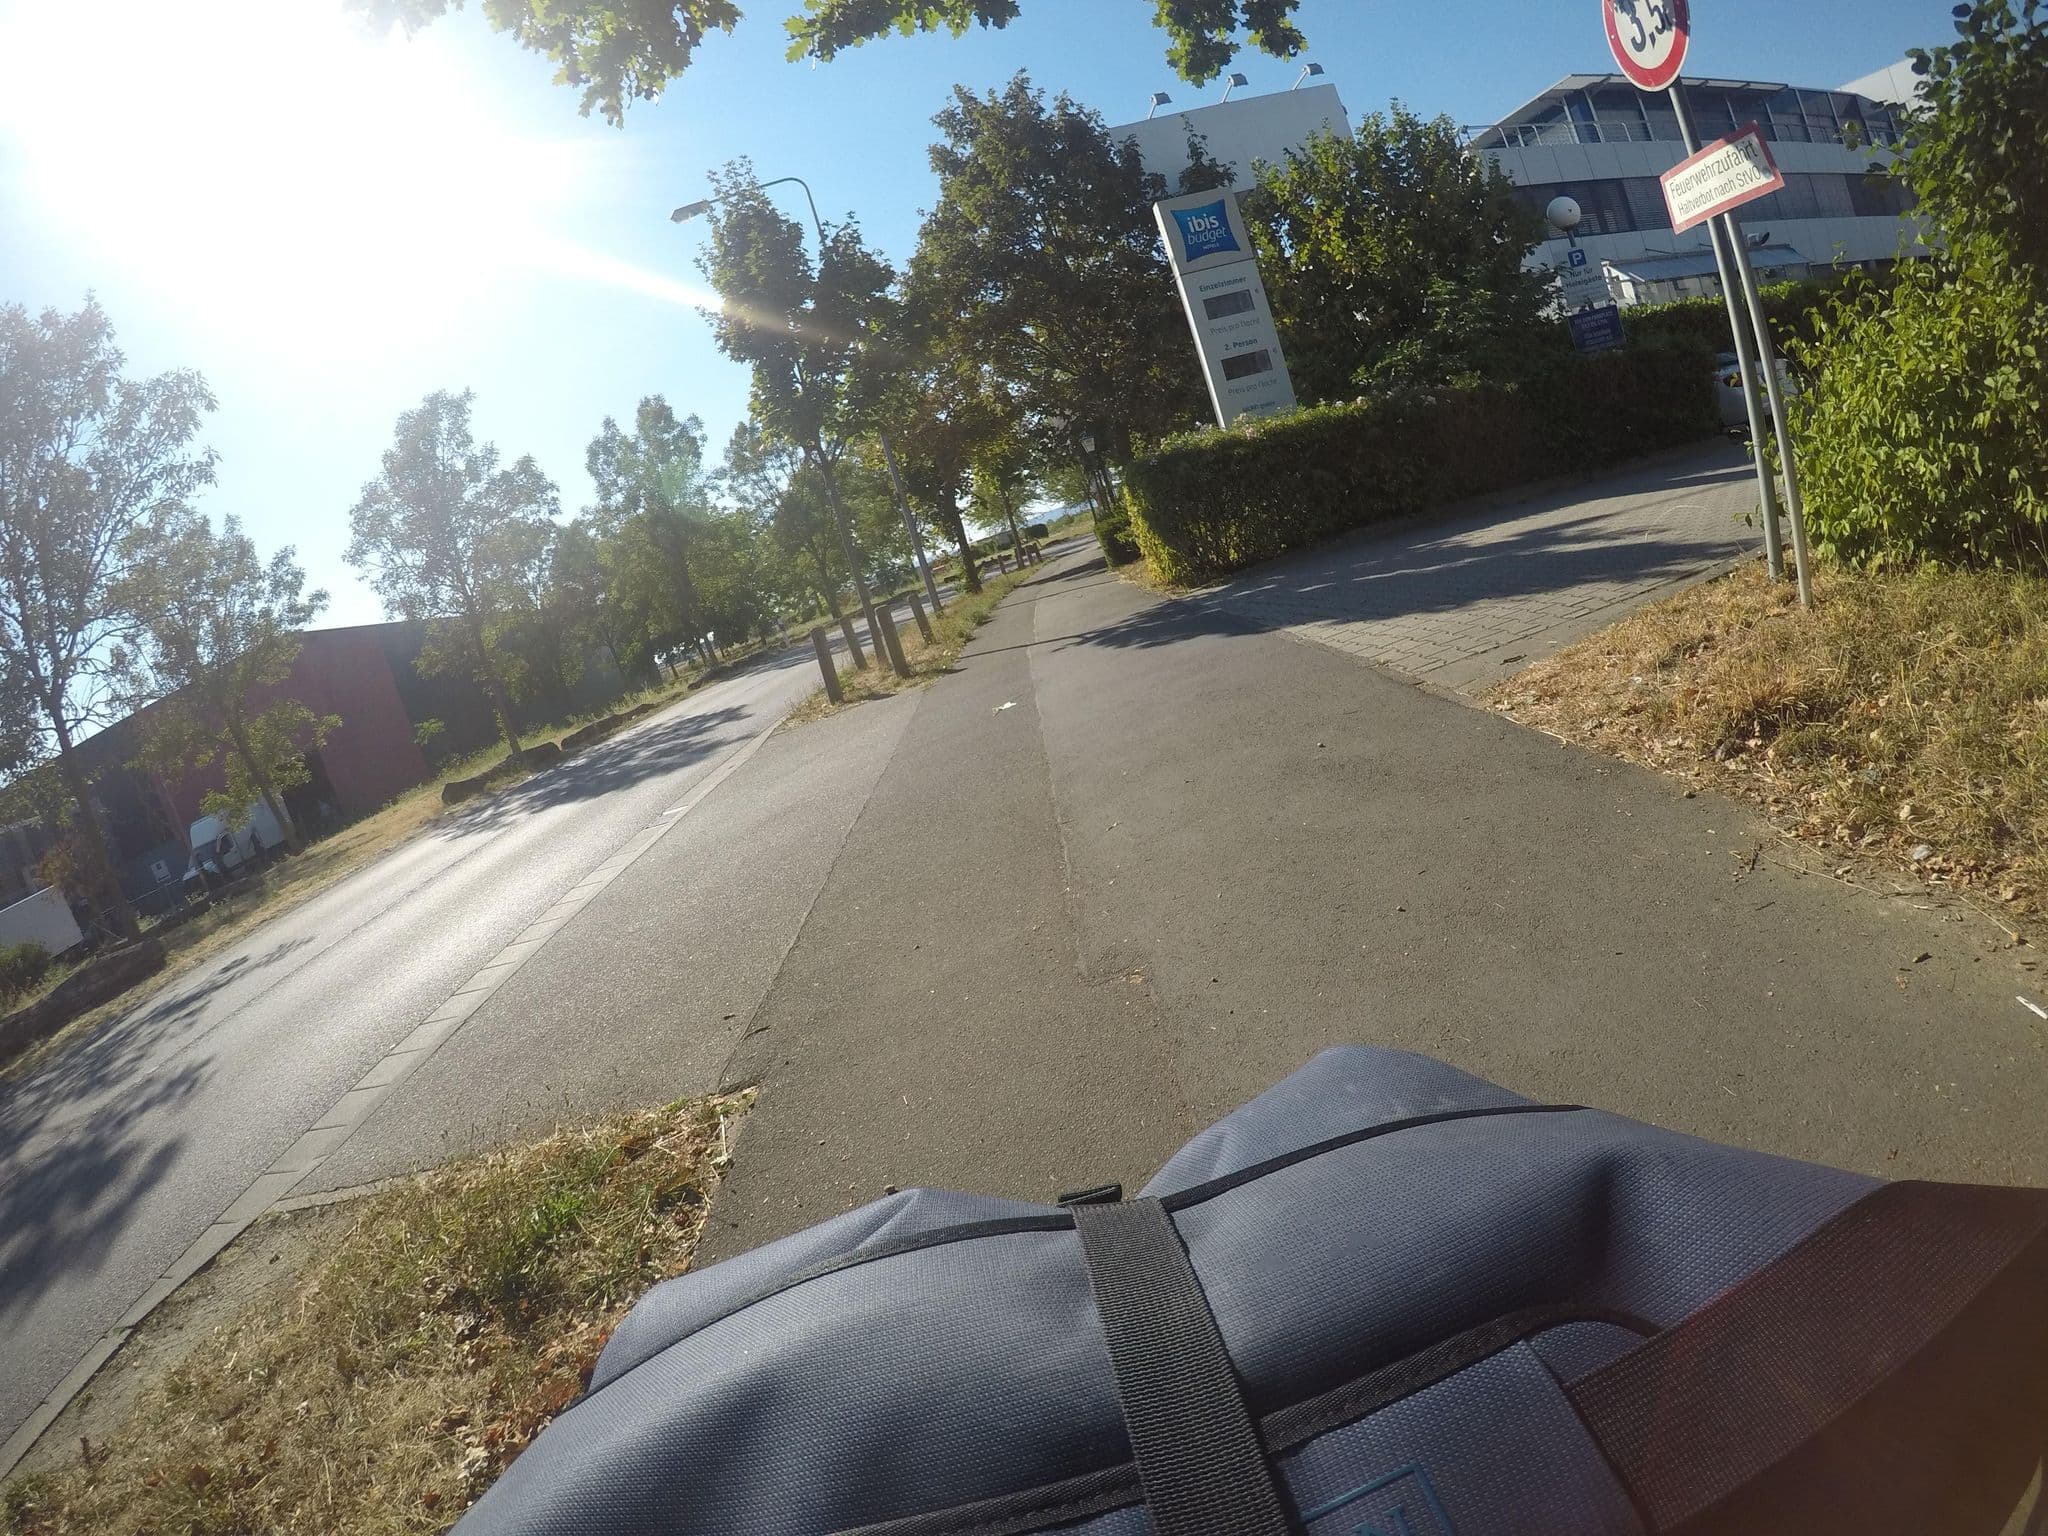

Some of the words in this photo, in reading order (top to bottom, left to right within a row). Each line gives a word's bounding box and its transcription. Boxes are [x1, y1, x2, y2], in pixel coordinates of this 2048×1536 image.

[1669, 141, 1758, 199] Feuerwehrzufahrt
[1677, 188, 1715, 216] Haltverbot
[1714, 178, 1737, 197] nach
[1736, 165, 1762, 188] StVO
[1187, 213, 1220, 233] ibis
[1187, 226, 1227, 246] budget
[1199, 276, 1247, 293] Einzelzimmer
[1209, 325, 1228, 336] Preis
[1228, 323, 1241, 334] pro
[1224, 342, 1233, 351] 2.
[1233, 337, 1258, 349] Person
